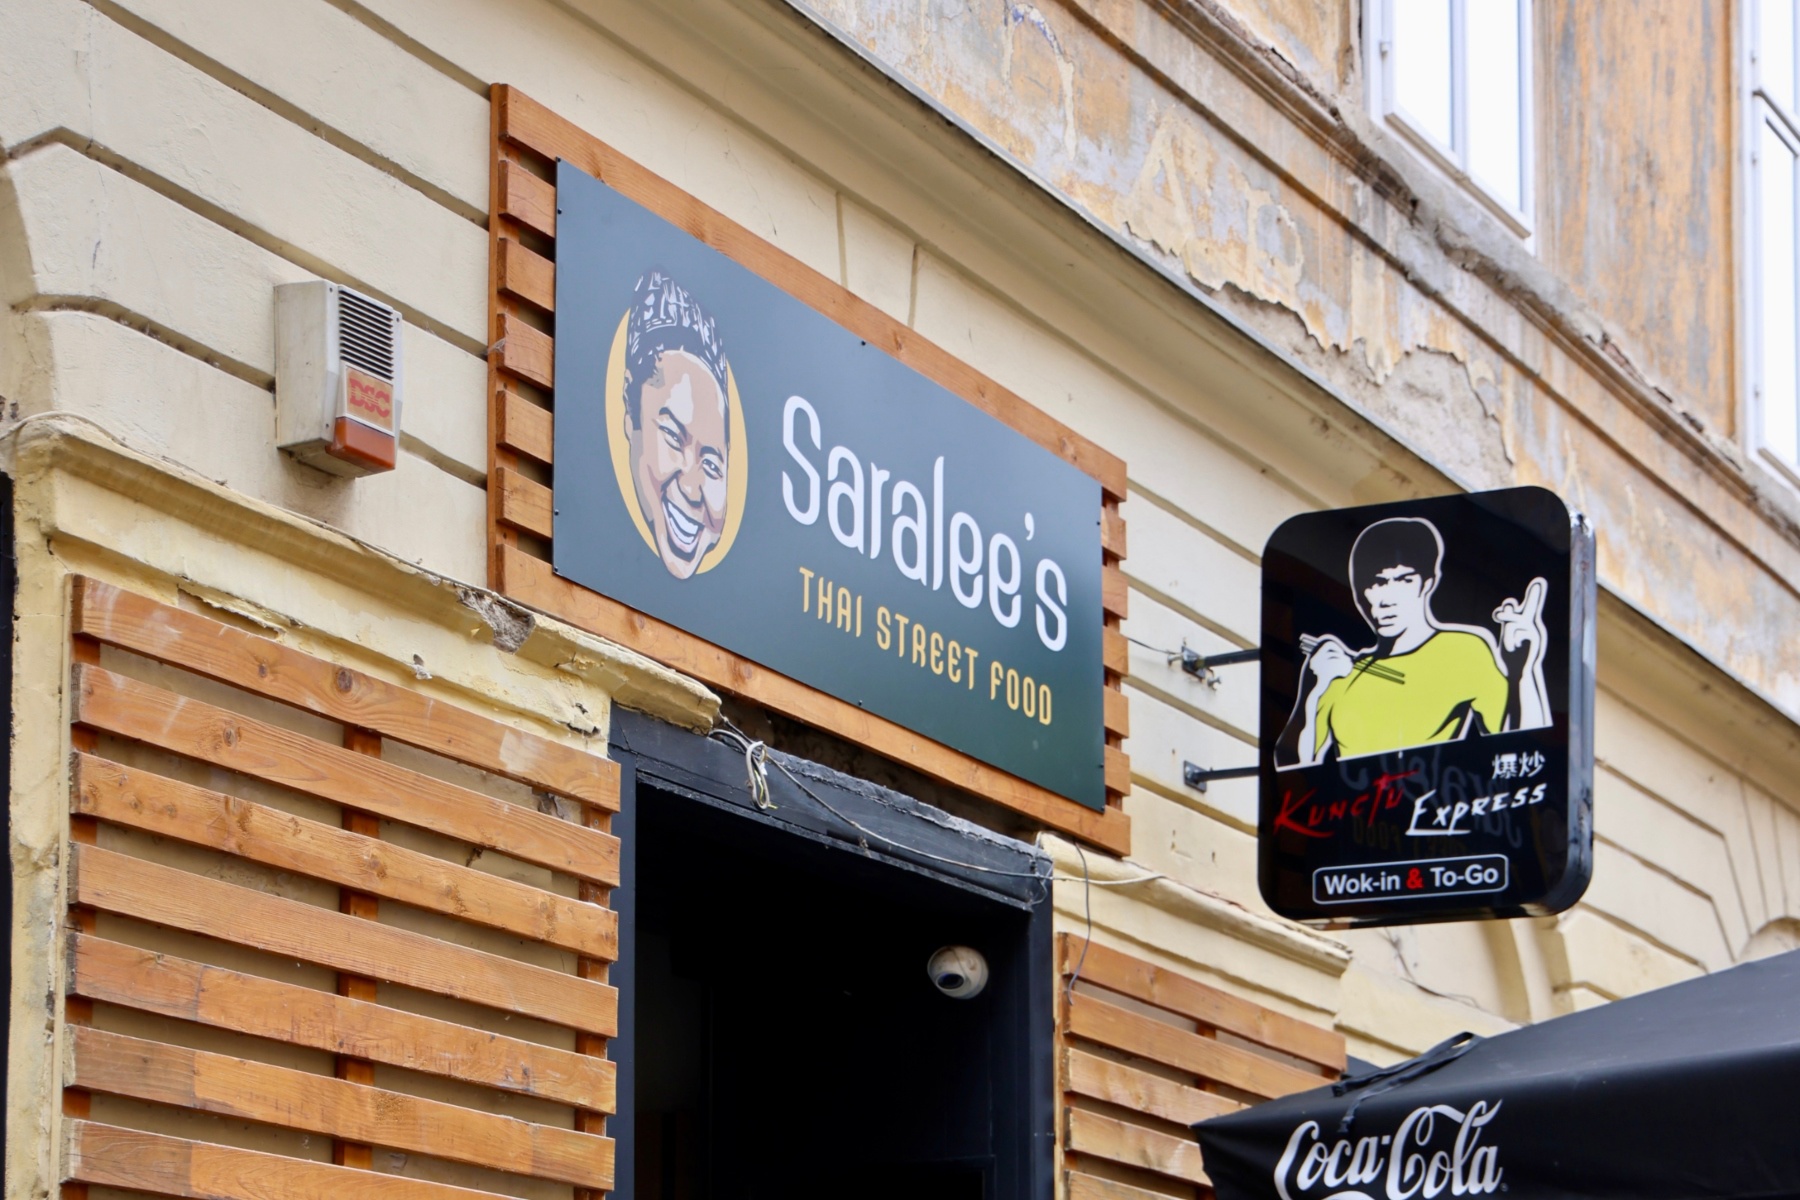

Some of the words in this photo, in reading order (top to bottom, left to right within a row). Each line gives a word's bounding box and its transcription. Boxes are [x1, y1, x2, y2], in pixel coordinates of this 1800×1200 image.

[349, 377, 391, 418] DSC
[782, 395, 1068, 652] Saralee's
[799, 566, 862, 637] THAI
[876, 605, 979, 690] STREET
[990, 660, 1052, 725] FOOD
[1491, 750, 1546, 779] 爆炒
[1405, 782, 1547, 836] EXPRESS
[1323, 871, 1401, 896] Wok-in
[1405, 867, 1424, 890] &
[1430, 863, 1499, 888] To-Go
[1273, 1099, 1503, 1200] Coca-Cola
